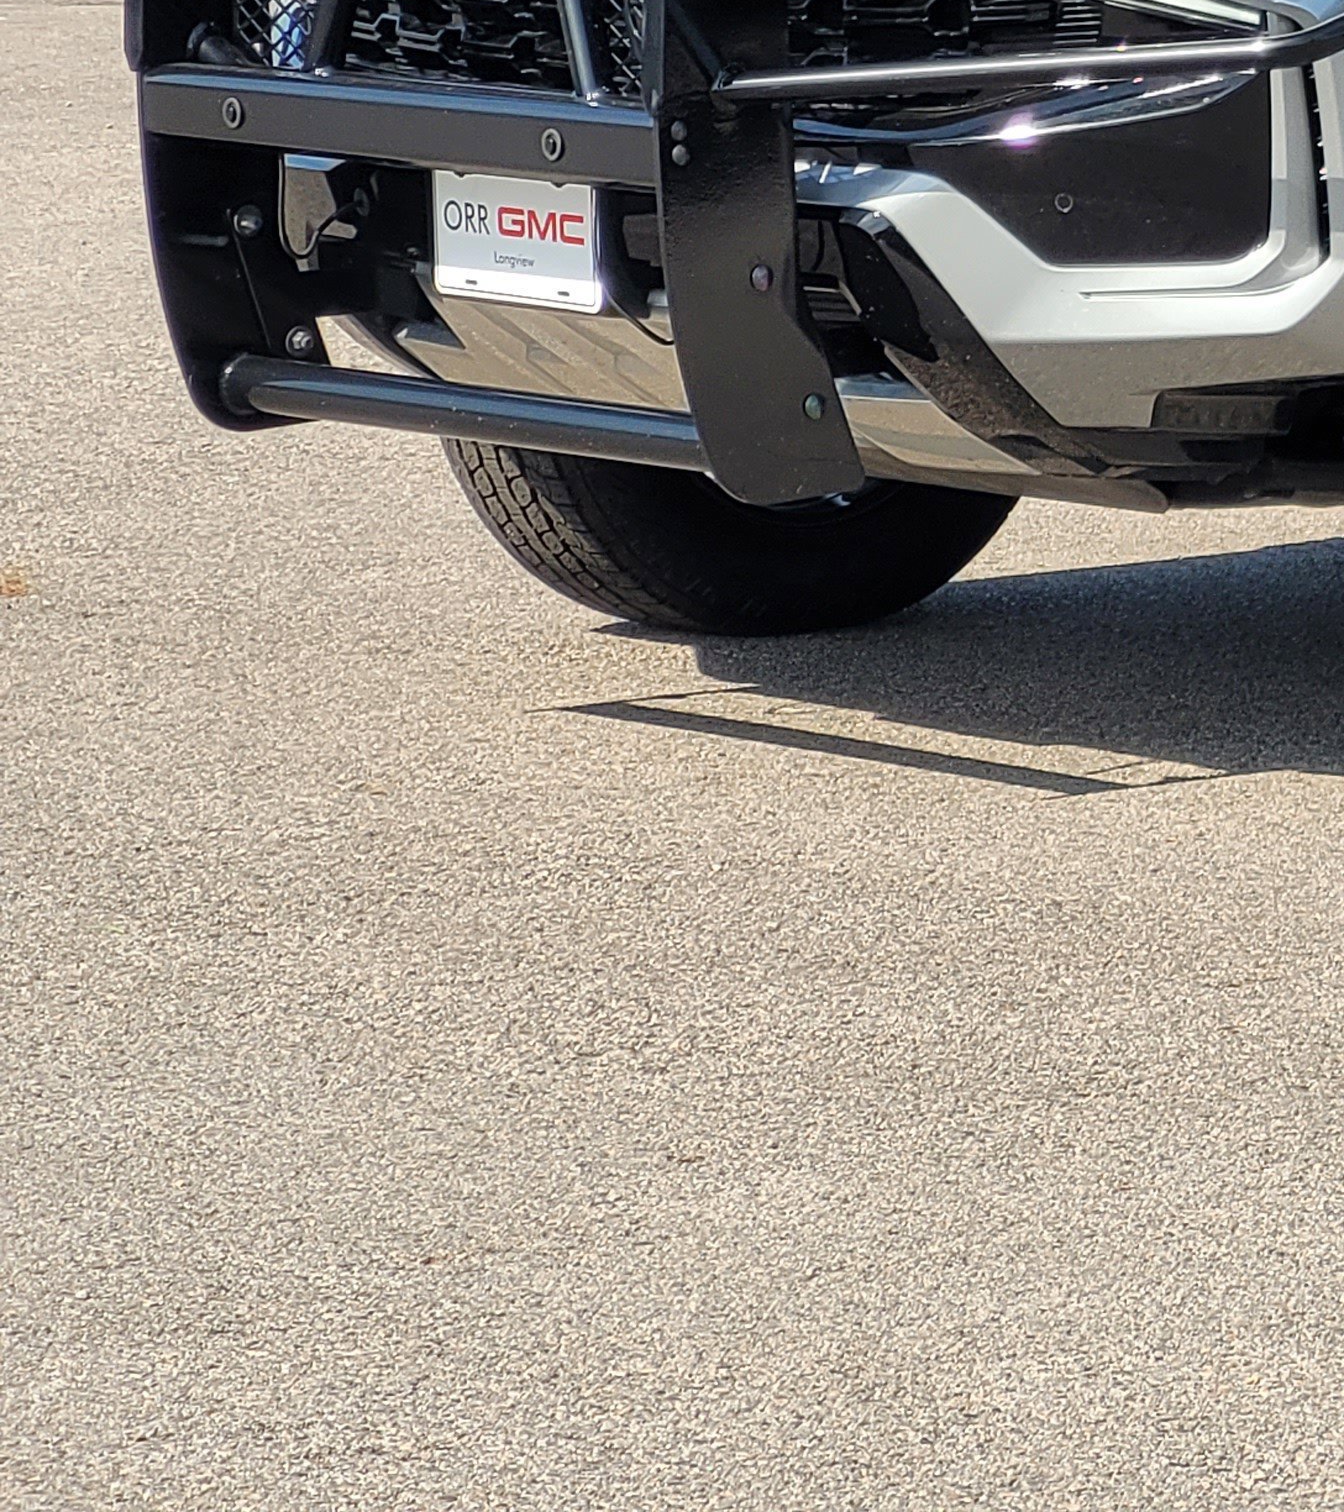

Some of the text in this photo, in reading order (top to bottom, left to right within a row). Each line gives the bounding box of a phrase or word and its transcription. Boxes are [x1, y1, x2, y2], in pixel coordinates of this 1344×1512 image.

[444, 199, 585, 246] ORR GMC
[494, 250, 536, 269] Longview
